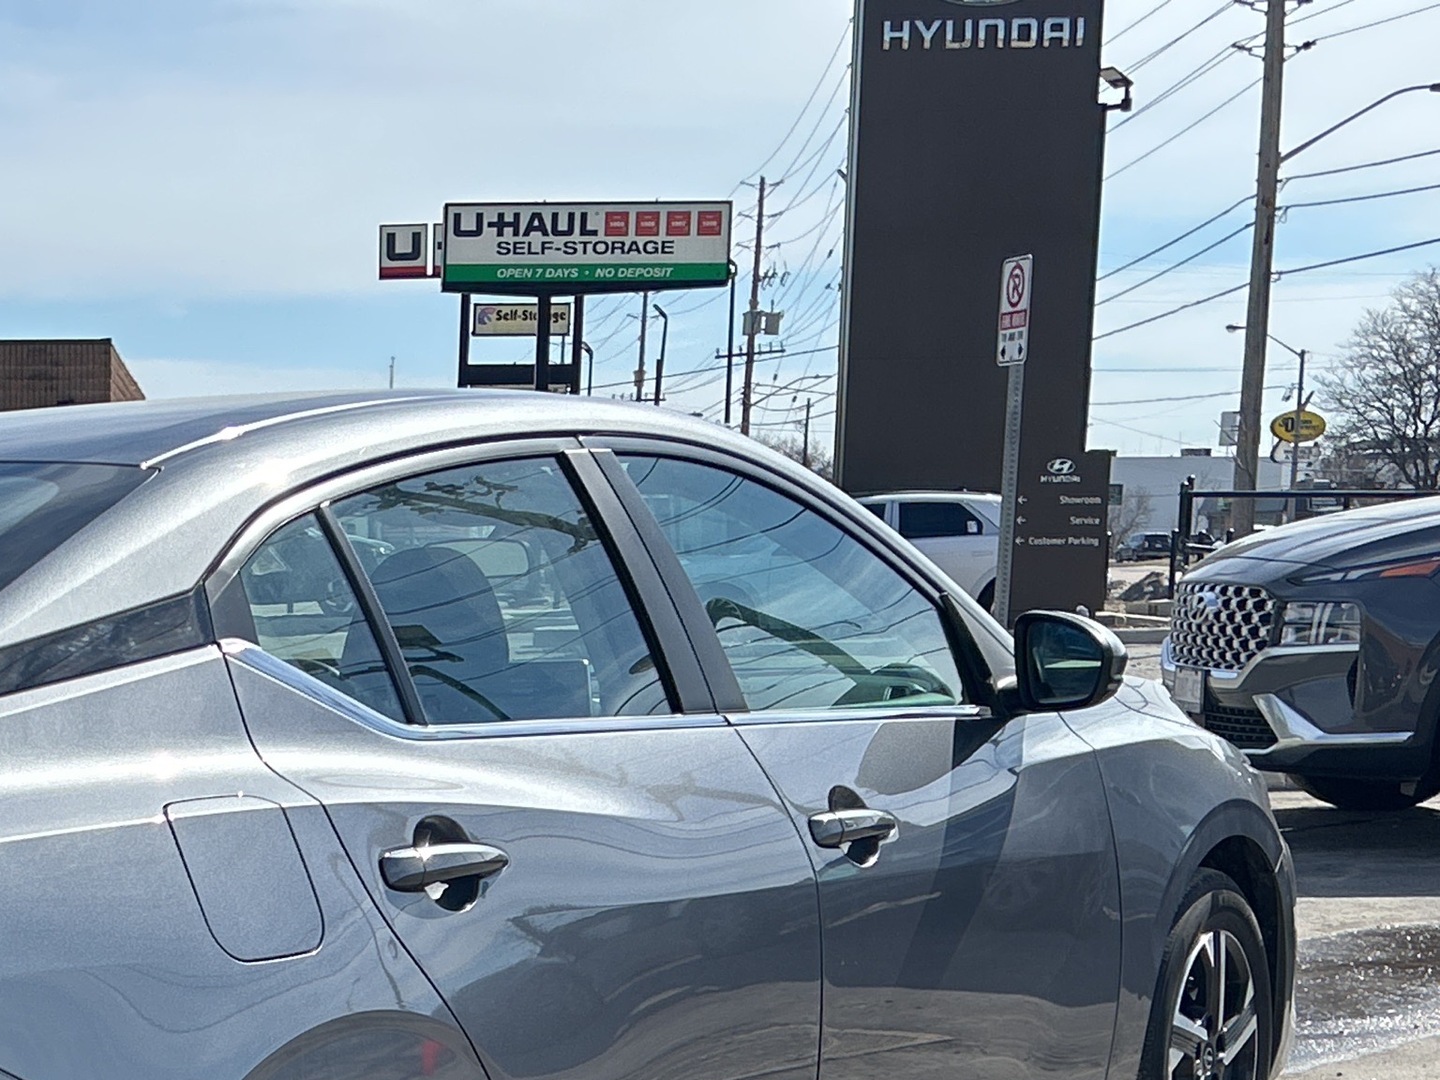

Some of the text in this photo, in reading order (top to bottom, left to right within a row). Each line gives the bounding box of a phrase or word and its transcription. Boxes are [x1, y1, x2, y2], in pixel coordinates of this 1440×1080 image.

[882, 17, 1085, 50] HYUNDAI
[453, 211, 598, 237] U-HAUL
[496, 240, 675, 256] SELF-STORAGE
[497, 267, 674, 279] OPEN 7 DAYS NO DEPOSIT
[1059, 495, 1102, 505] Showroom
[1069, 516, 1100, 525] Service
[1028, 536, 1099, 546] Customer Parking
